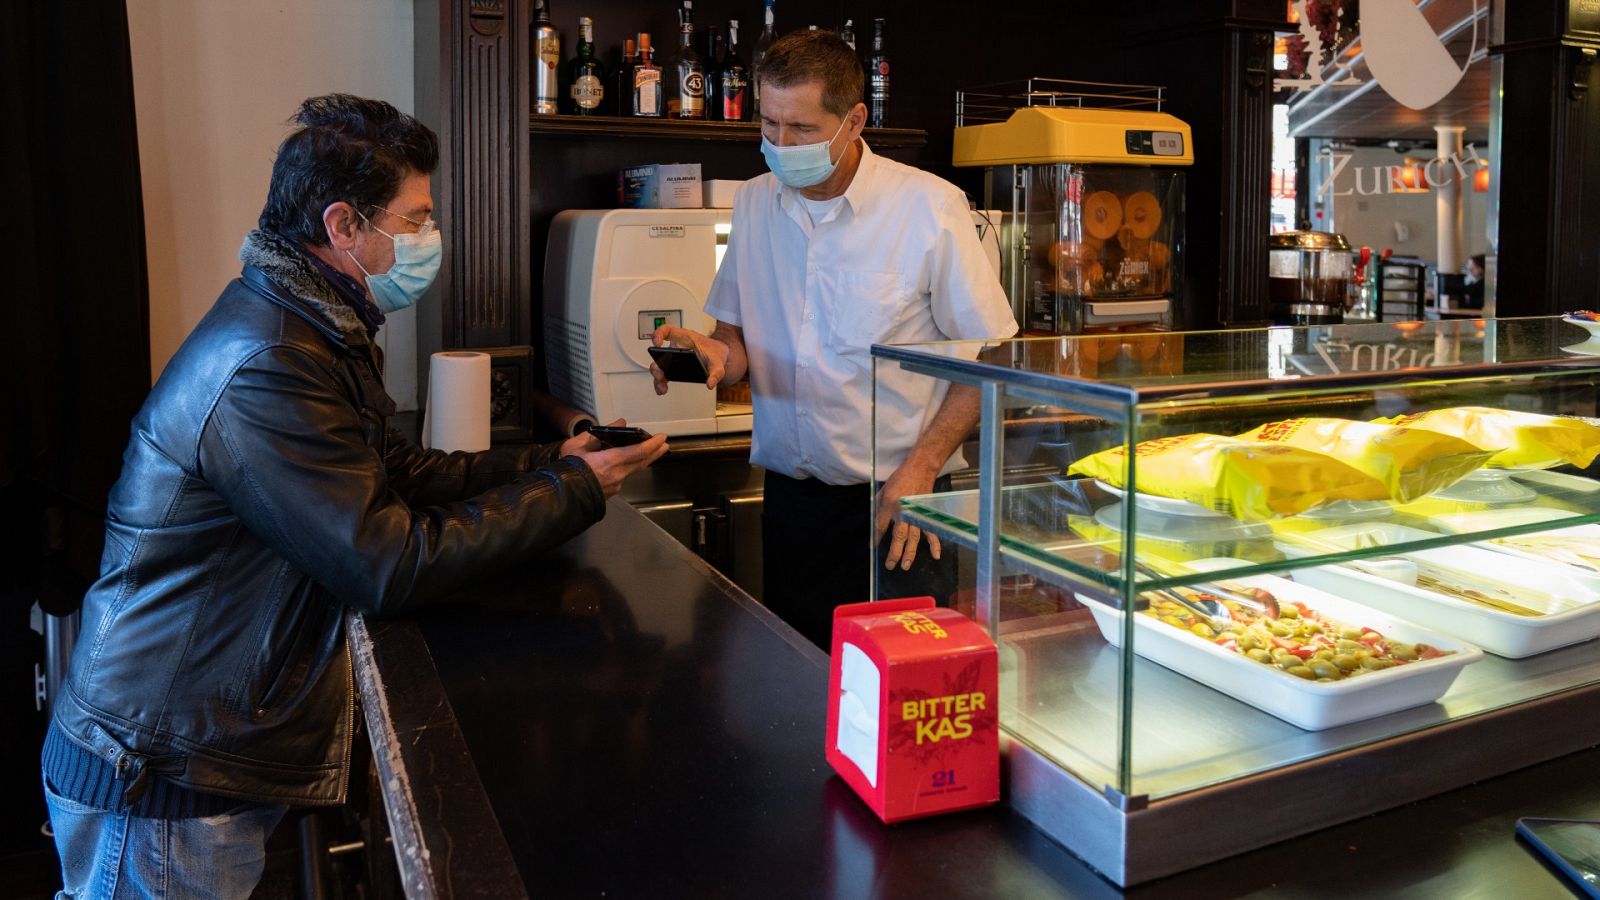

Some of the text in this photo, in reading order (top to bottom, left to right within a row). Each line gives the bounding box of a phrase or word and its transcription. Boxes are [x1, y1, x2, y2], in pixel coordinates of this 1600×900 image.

[687, 78, 703, 90] 43
[902, 692, 986, 720] BITTER
[916, 714, 974, 745] KAS
